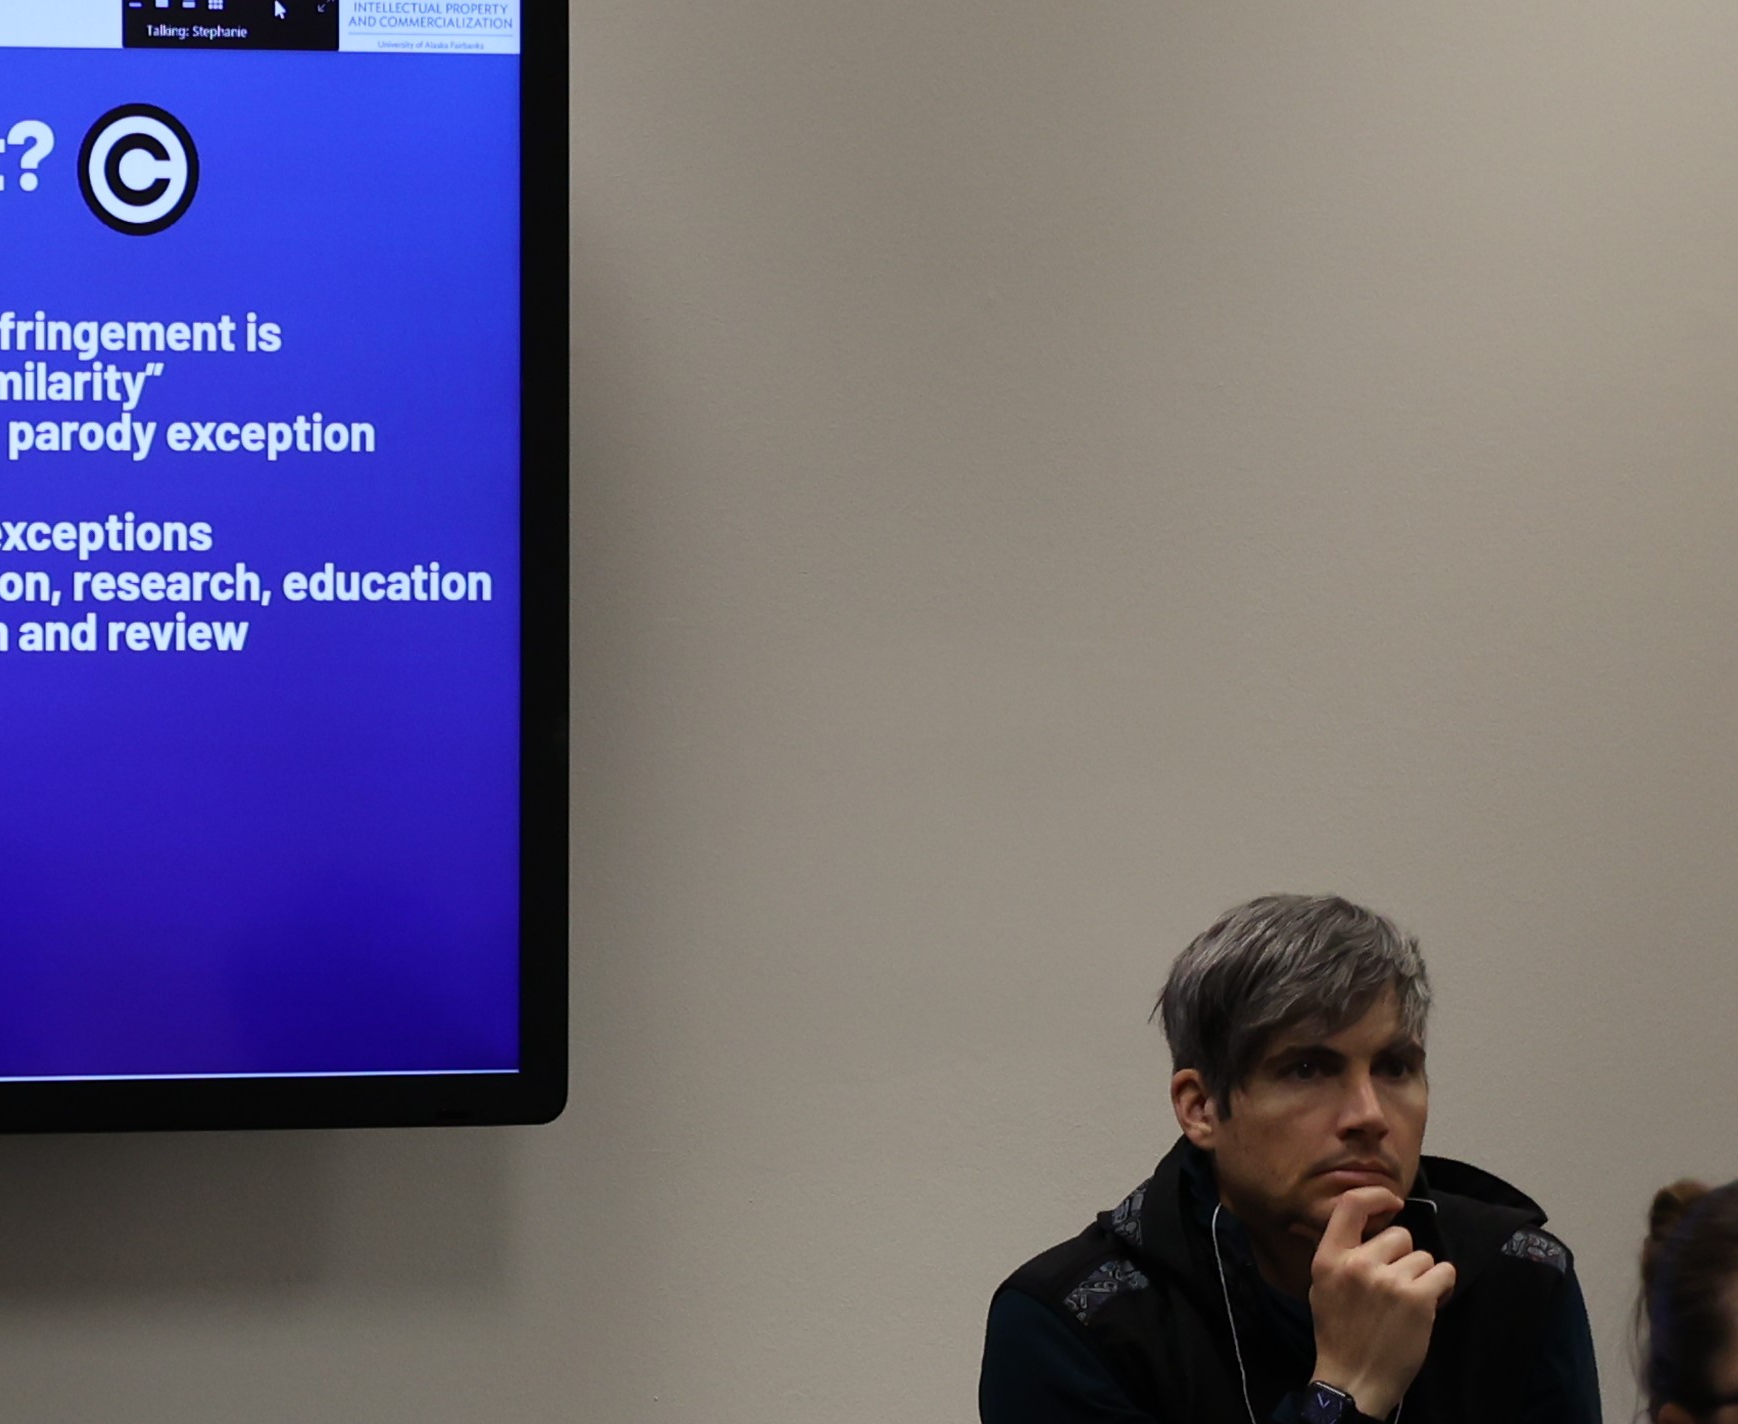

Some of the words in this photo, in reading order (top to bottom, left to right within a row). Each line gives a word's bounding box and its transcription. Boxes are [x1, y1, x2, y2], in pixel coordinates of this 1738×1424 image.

[348, 16, 376, 28] AND
[379, 16, 514, 29] COMMERCIALIZATION
[353, 2, 443, 14] INTELLECTUAL
[445, 3, 509, 15] PROPERTY
[146, 24, 190, 40] Talking:
[192, 25, 248, 40] Stephanie
[246, 311, 282, 352] is
[8, 413, 157, 462] parody
[166, 413, 375, 461] exception
[73, 562, 272, 607] research,
[283, 561, 492, 601] education
[18, 612, 97, 652] and
[108, 614, 249, 652] review
